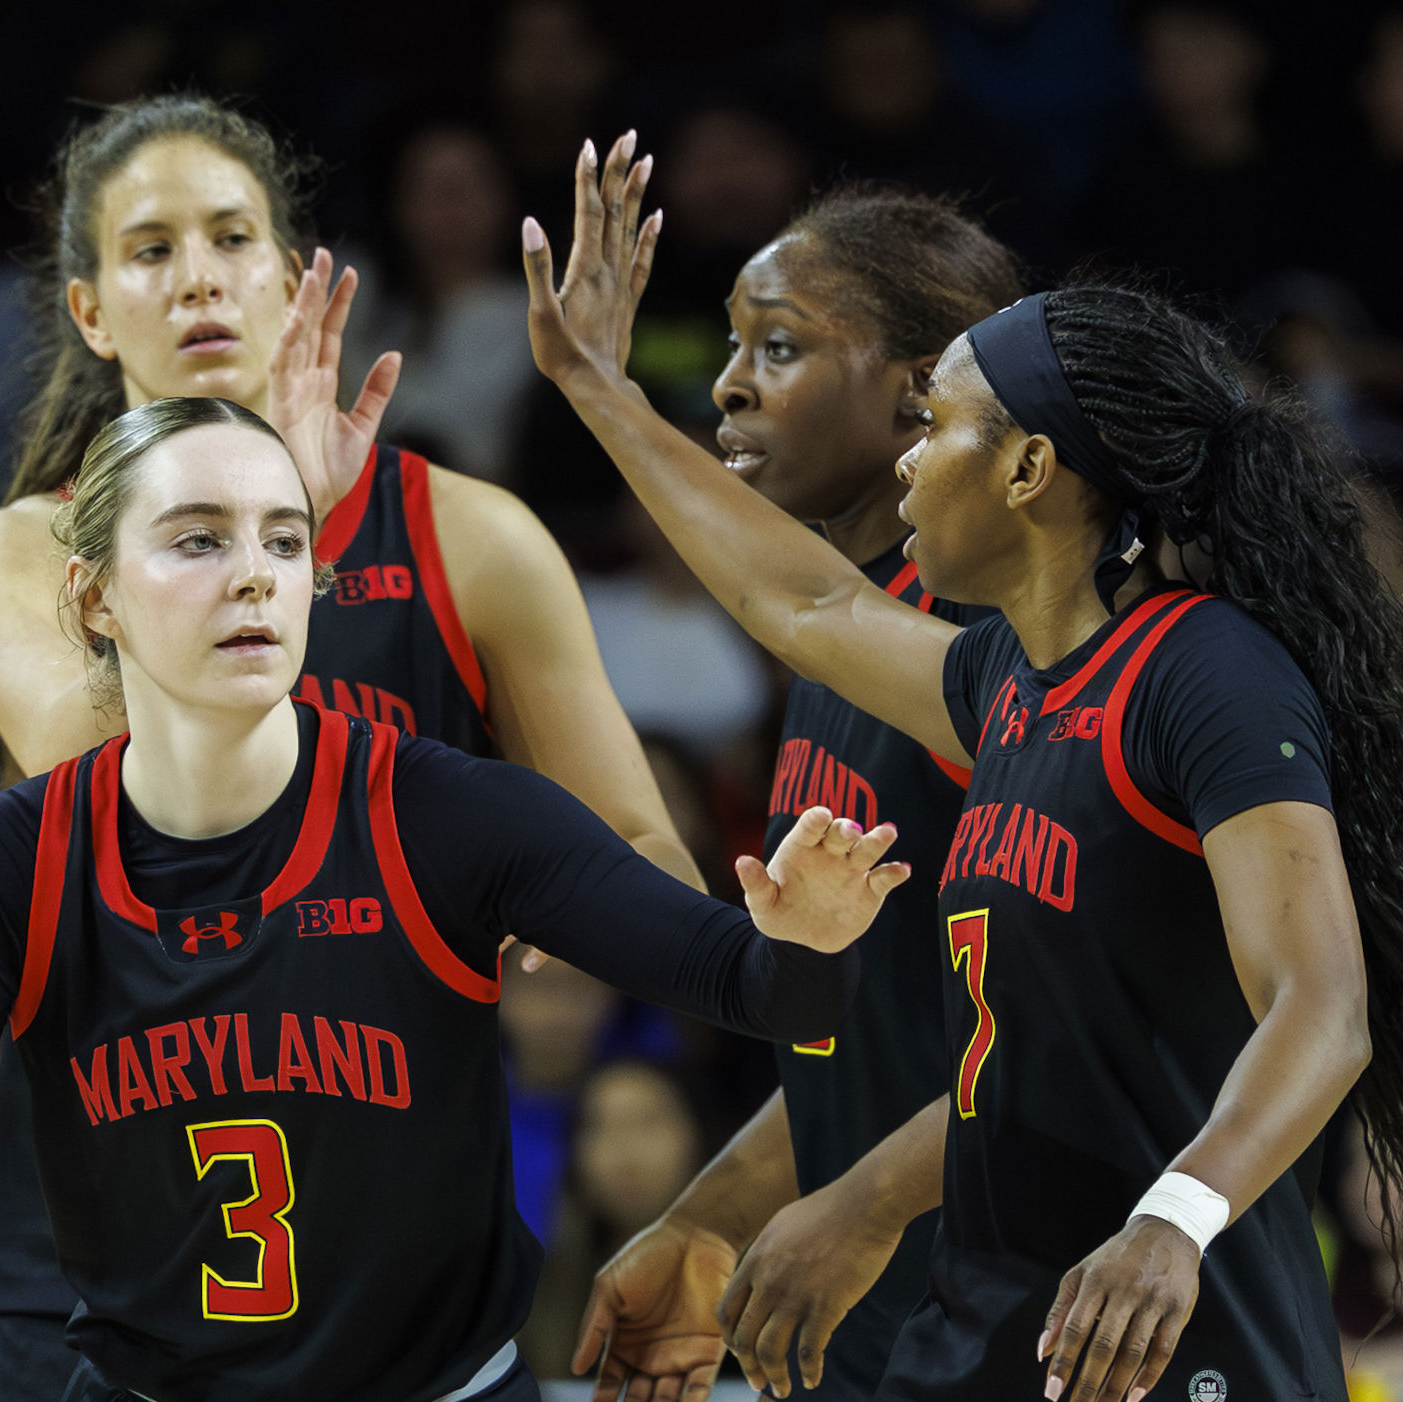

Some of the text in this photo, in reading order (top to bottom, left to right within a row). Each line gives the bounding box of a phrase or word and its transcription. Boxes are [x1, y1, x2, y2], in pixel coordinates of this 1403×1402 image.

[71, 1011, 412, 1127] MARYLAND
[947, 907, 997, 1121] 7
[186, 1117, 301, 1323] 3
[1198, 1381, 1217, 1393] SM
